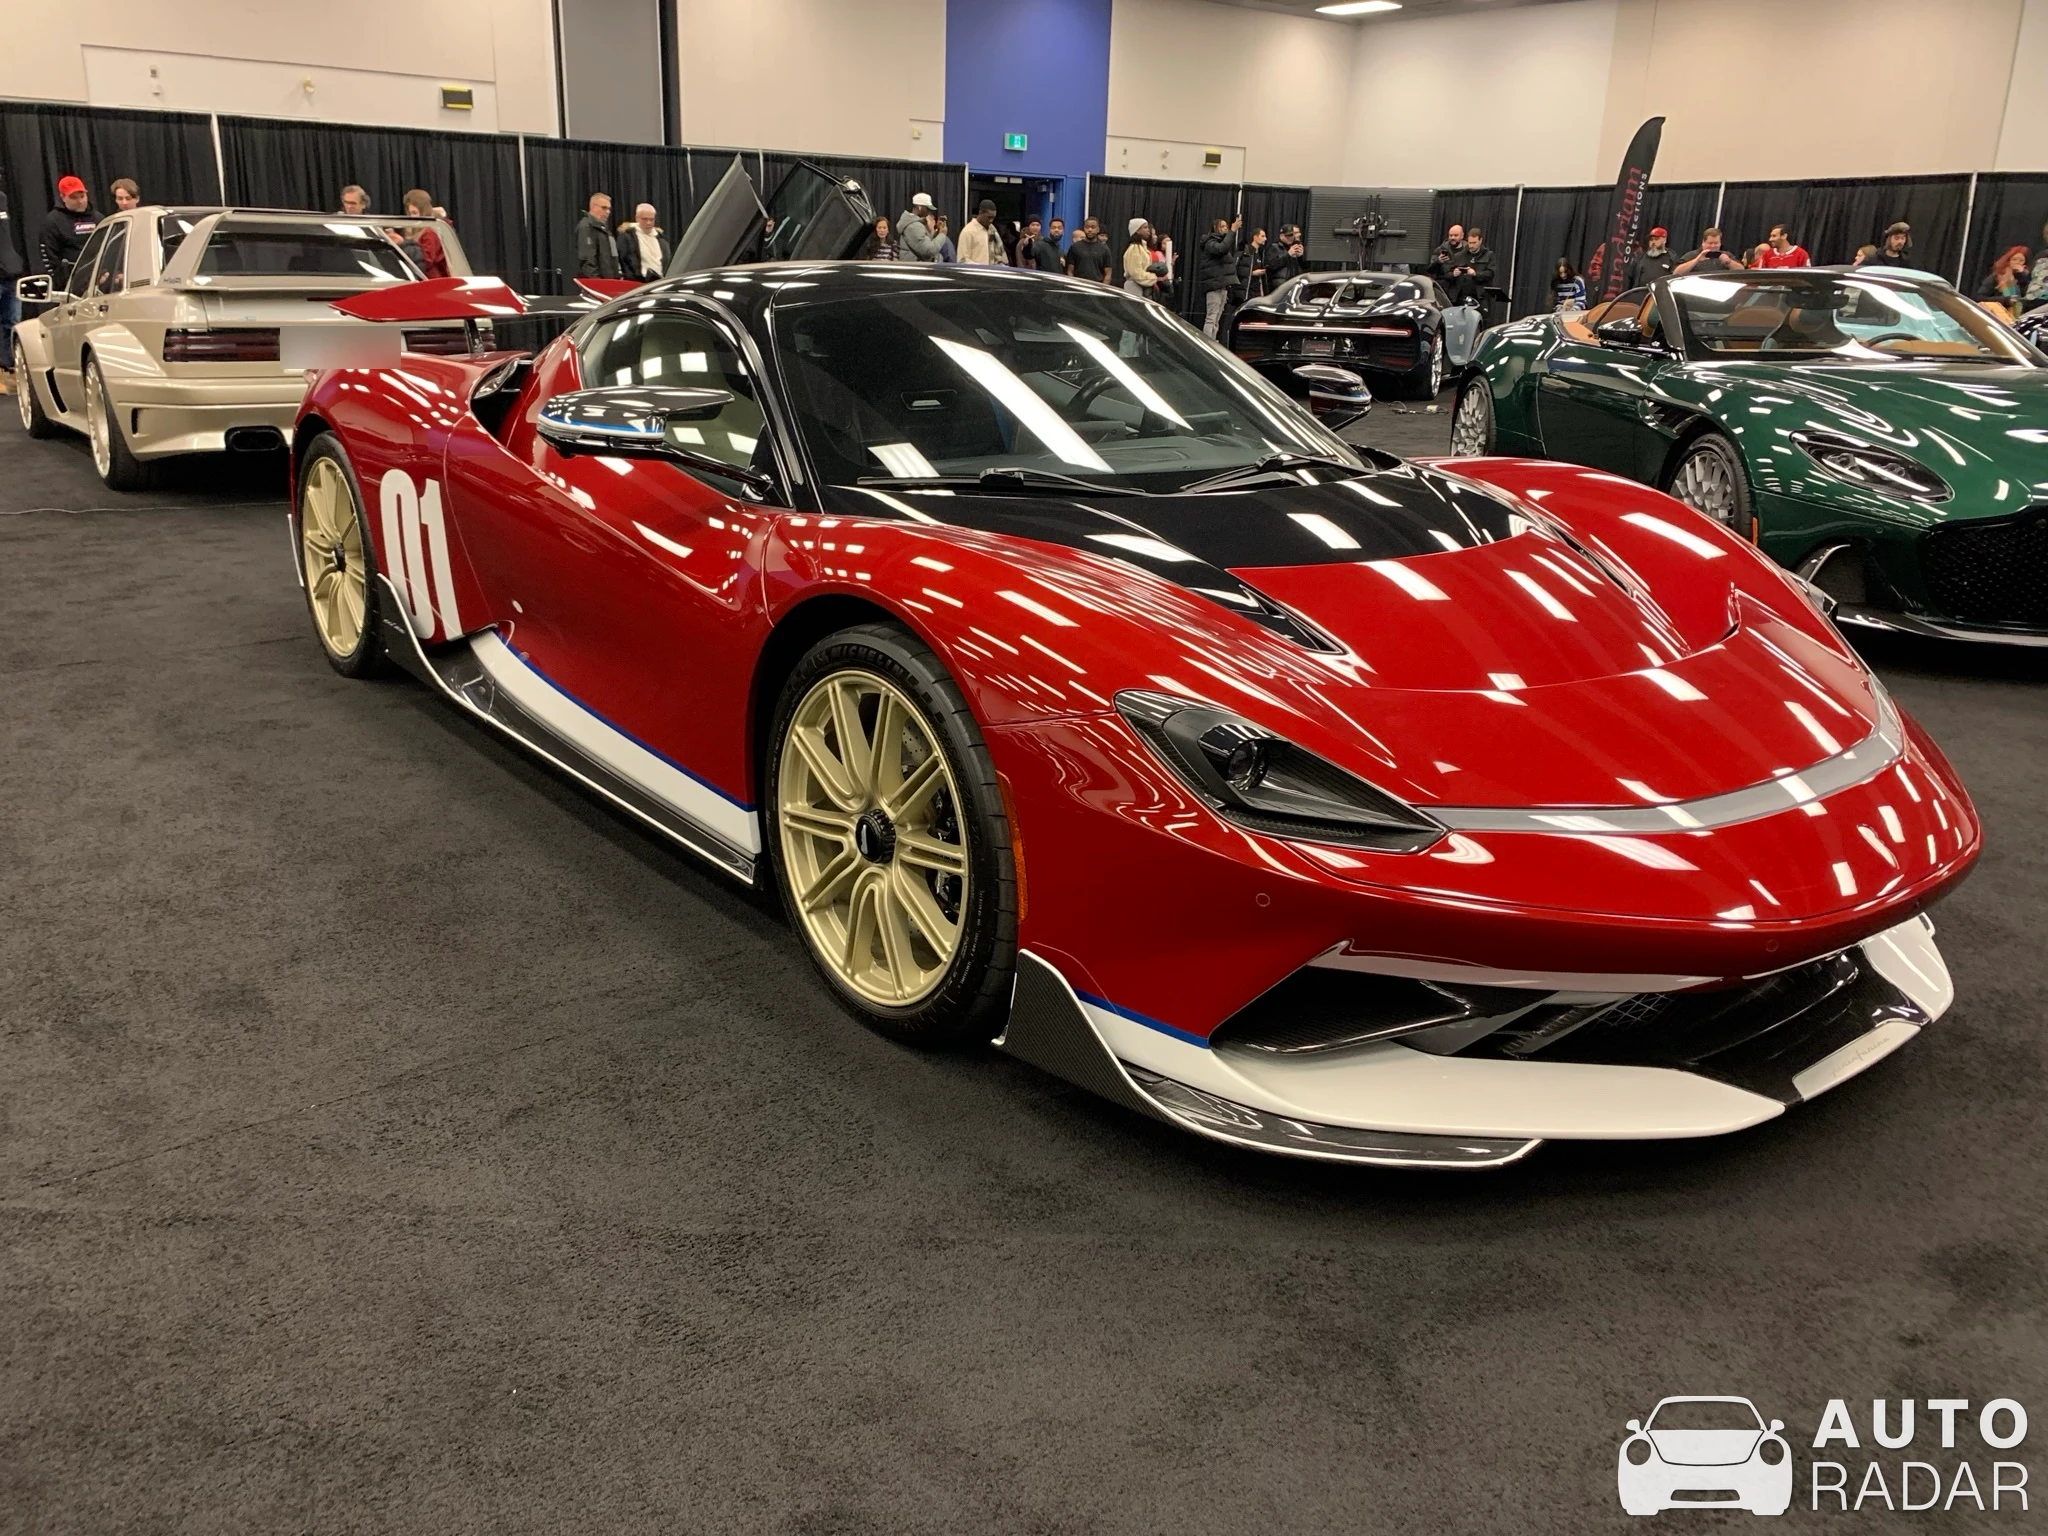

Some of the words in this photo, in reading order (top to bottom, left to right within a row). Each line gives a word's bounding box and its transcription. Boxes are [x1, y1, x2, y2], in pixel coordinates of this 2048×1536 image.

[1624, 173, 1648, 263] COLLECTIONS
[379, 468, 465, 641] 01
[831, 644, 920, 687] MICHELIN
